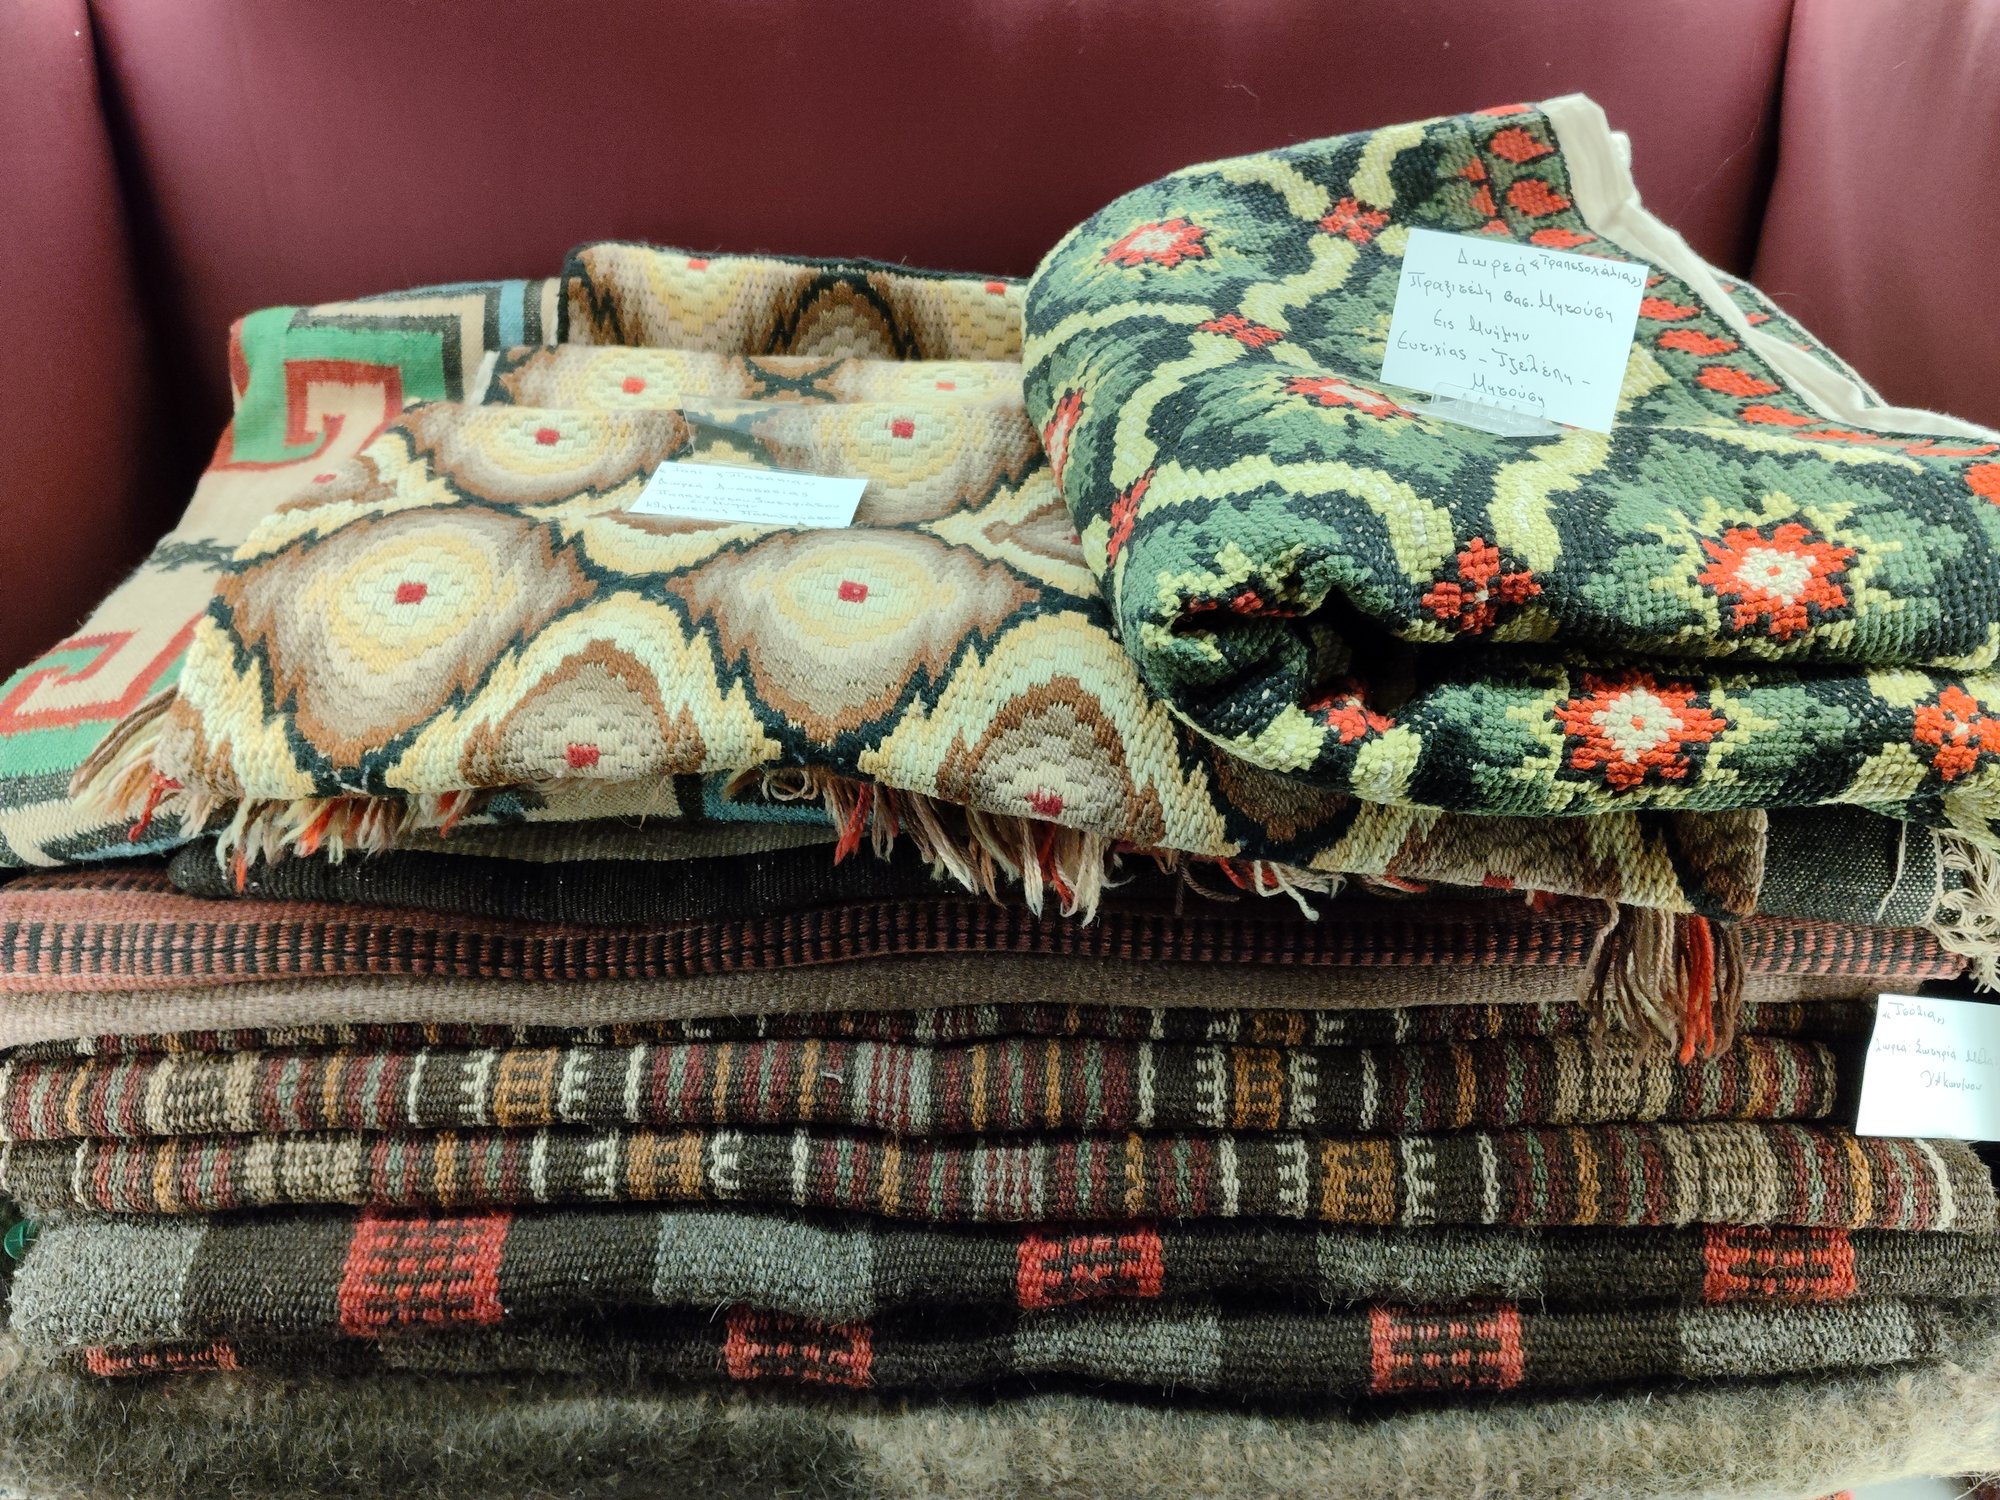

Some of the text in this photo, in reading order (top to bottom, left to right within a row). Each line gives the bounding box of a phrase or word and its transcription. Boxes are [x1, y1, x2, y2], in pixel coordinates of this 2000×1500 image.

[1457, 247, 1527, 279] Δωρεά
[1407, 271, 1492, 303] Πραξιτέλη
[1538, 290, 1614, 324] Μητούση
[1470, 373, 1545, 405] Μητούση
